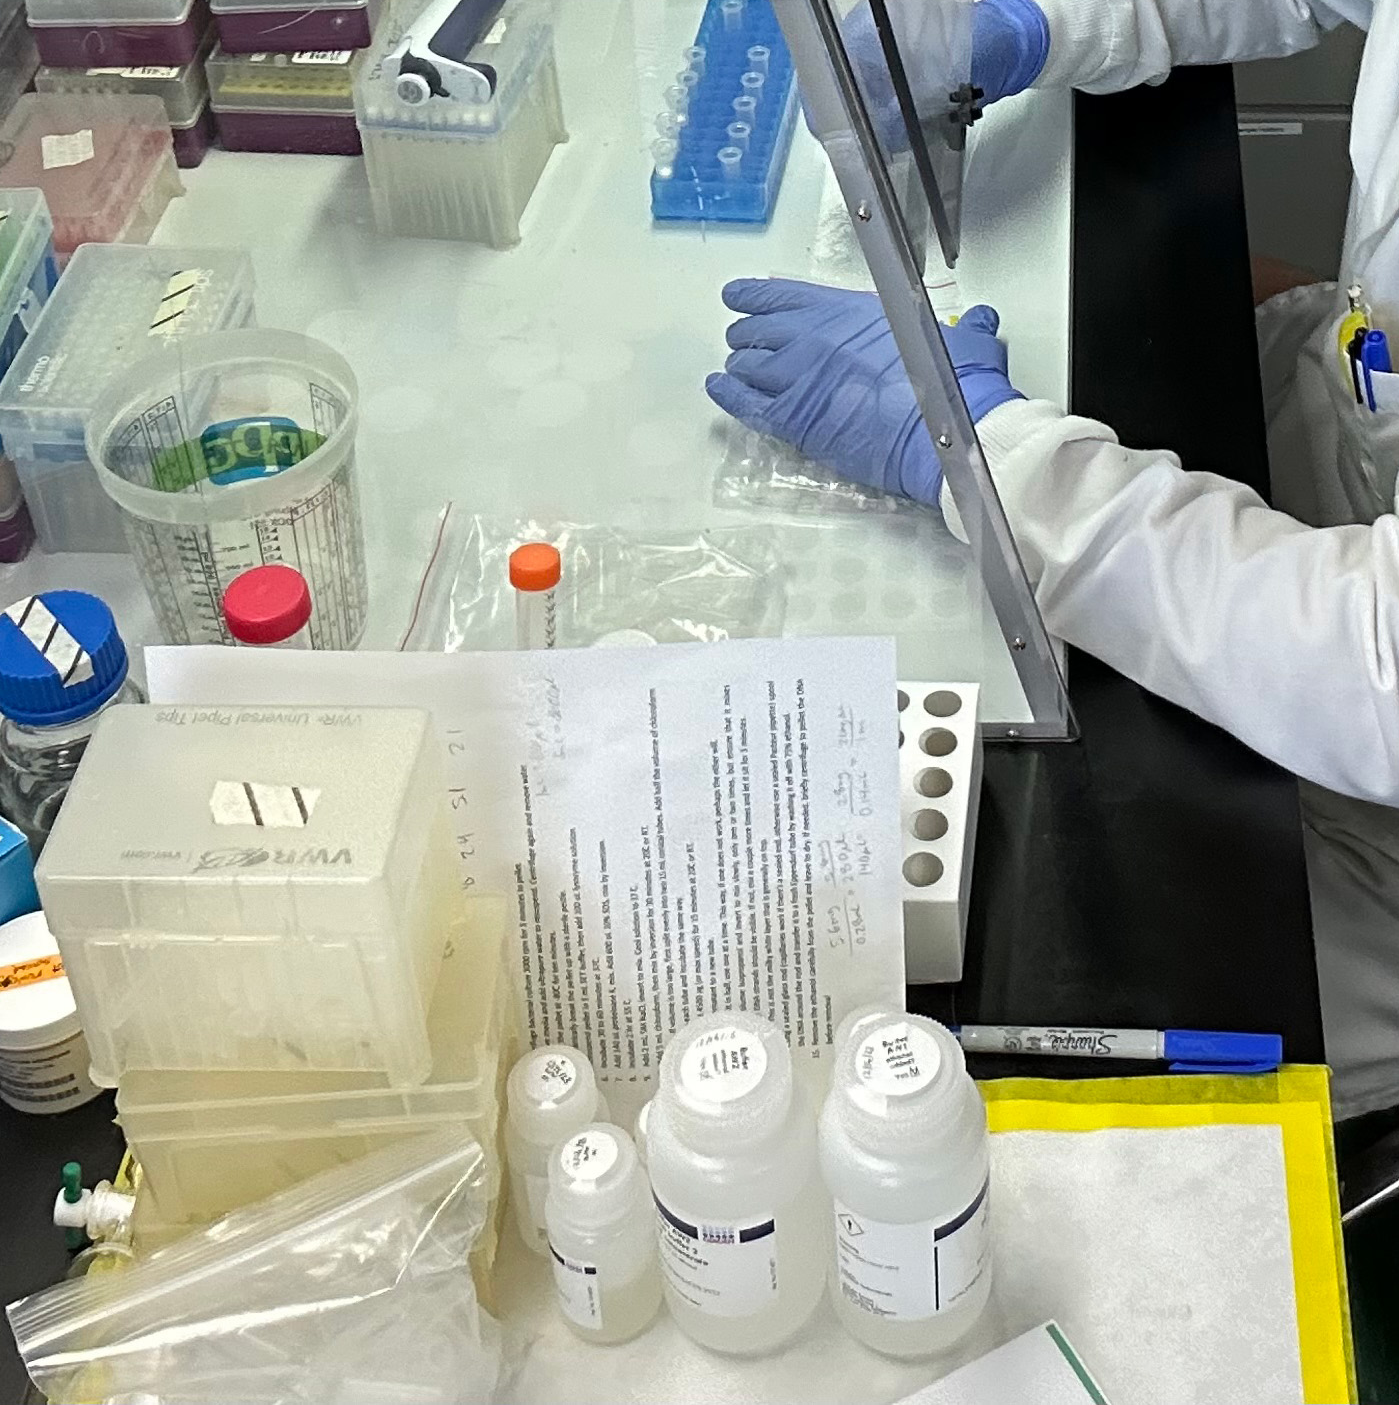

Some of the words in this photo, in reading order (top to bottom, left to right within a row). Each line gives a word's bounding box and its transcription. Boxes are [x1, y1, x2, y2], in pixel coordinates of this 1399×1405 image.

[18, 355, 50, 392] thermo
[155, 710, 187, 725] Tips
[236, 712, 310, 727] Universal
[273, 848, 352, 865] VWR
[1047, 1032, 1119, 1057] Sharpie
